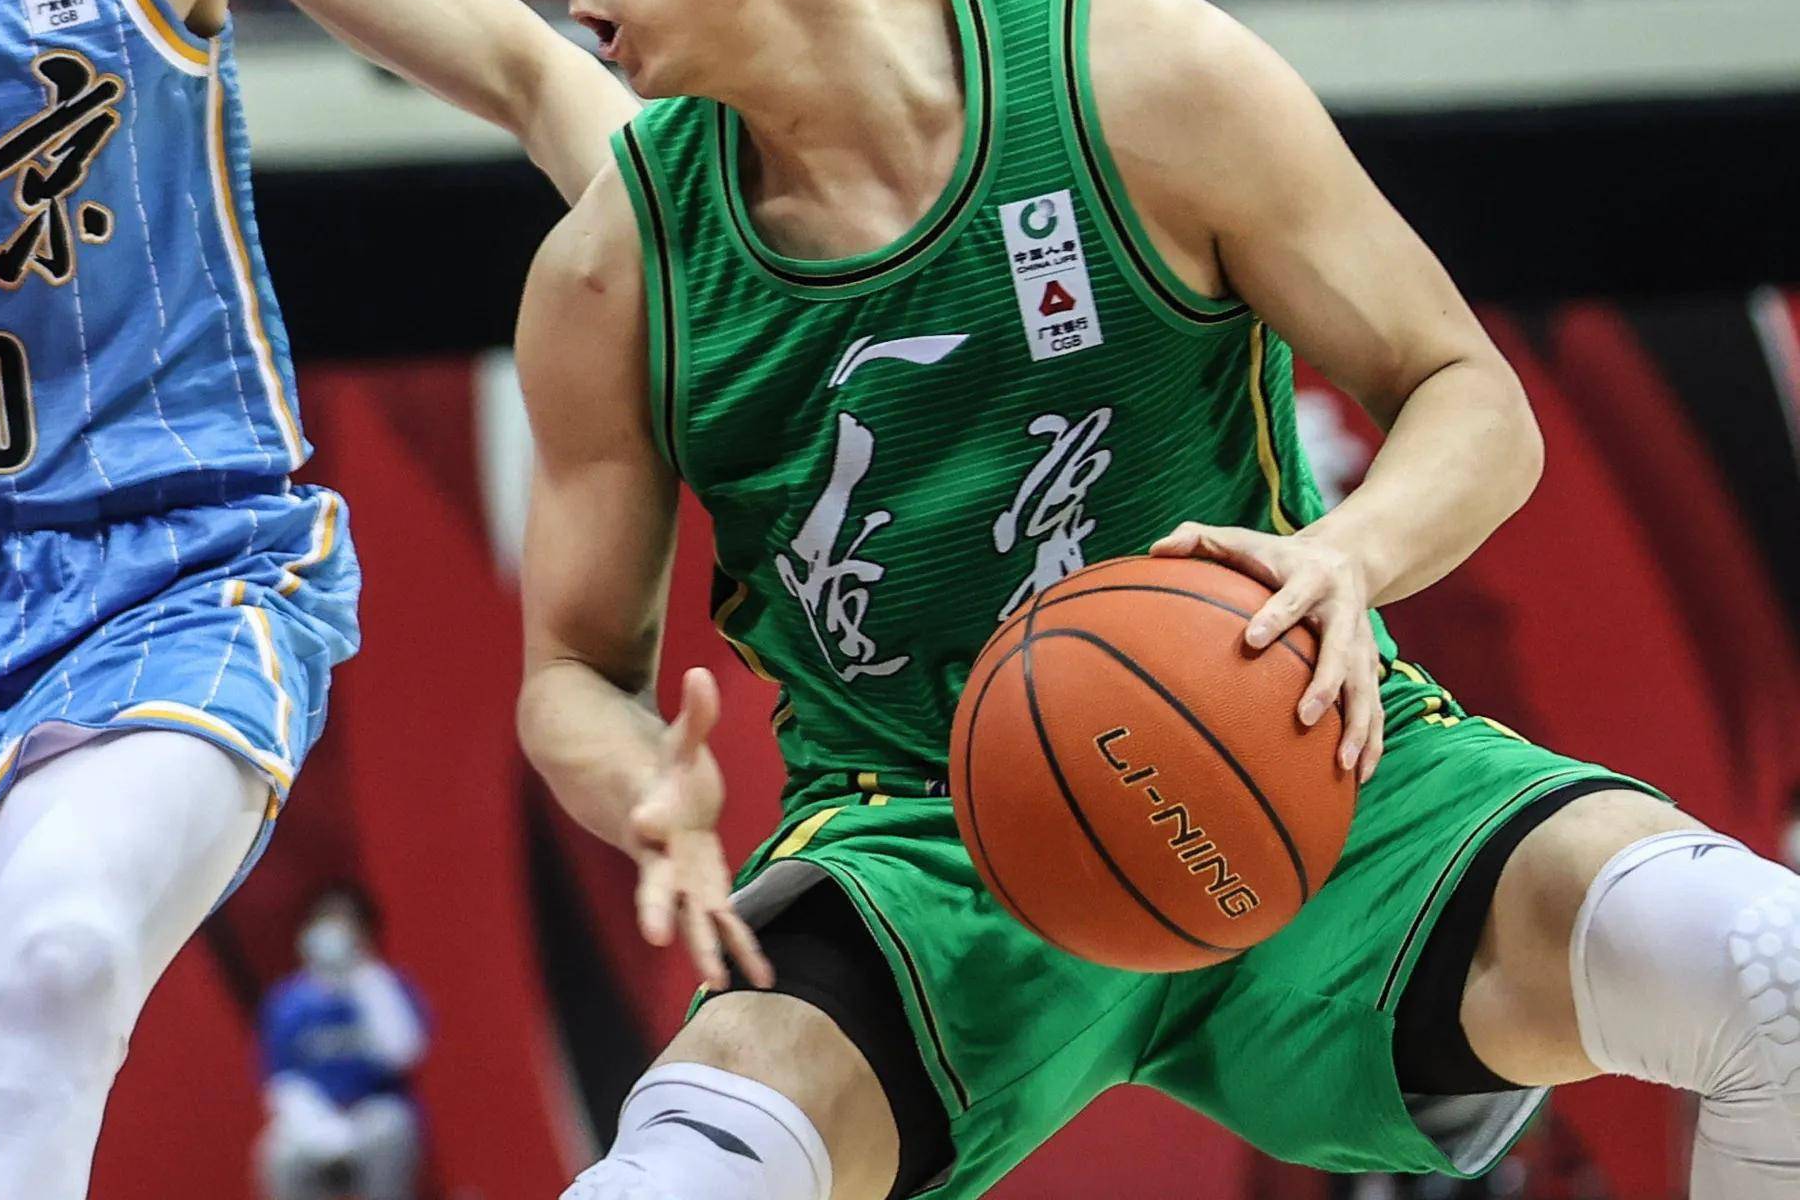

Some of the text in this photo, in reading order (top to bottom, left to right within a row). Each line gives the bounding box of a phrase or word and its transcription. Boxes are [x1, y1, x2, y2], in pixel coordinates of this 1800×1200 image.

[50, 9, 79, 27] CGB
[1050, 334, 1083, 352] CGB
[1093, 726, 1261, 919] LI-NING
